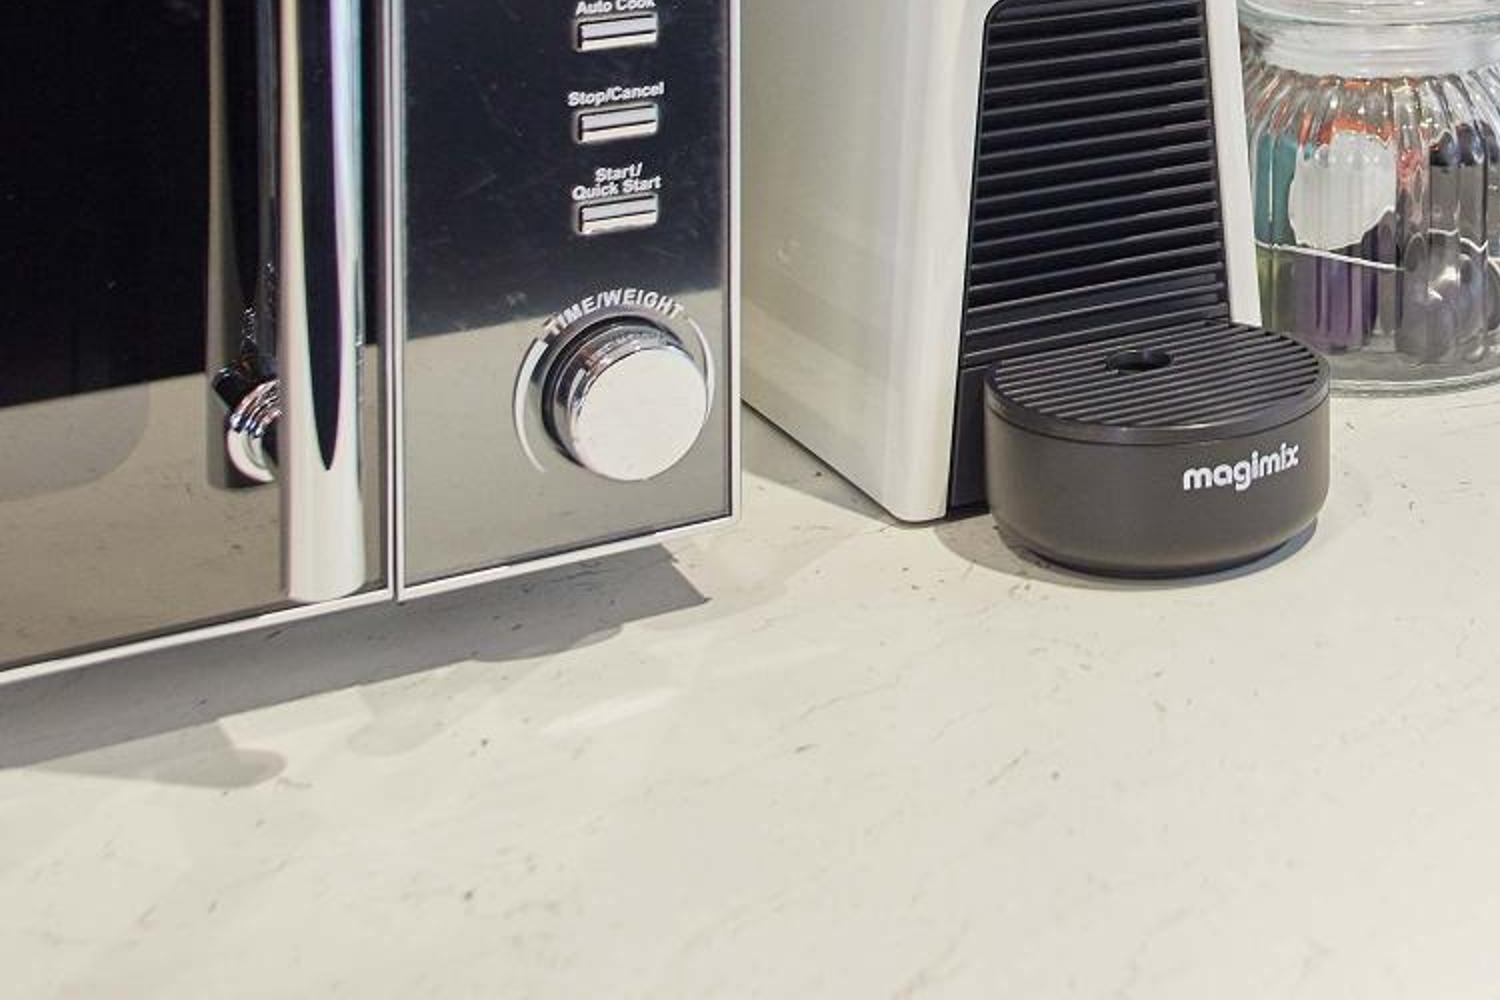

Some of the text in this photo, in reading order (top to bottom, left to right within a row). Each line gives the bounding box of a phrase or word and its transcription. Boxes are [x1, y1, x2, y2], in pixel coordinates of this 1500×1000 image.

[575, 1, 613, 15] Auto
[567, 82, 664, 107] Stop/Cancel
[595, 163, 643, 183] Start/
[572, 177, 661, 200] Quick Start
[547, 288, 684, 334] TIME/WEIGHT
[1183, 443, 1299, 491] magimix
